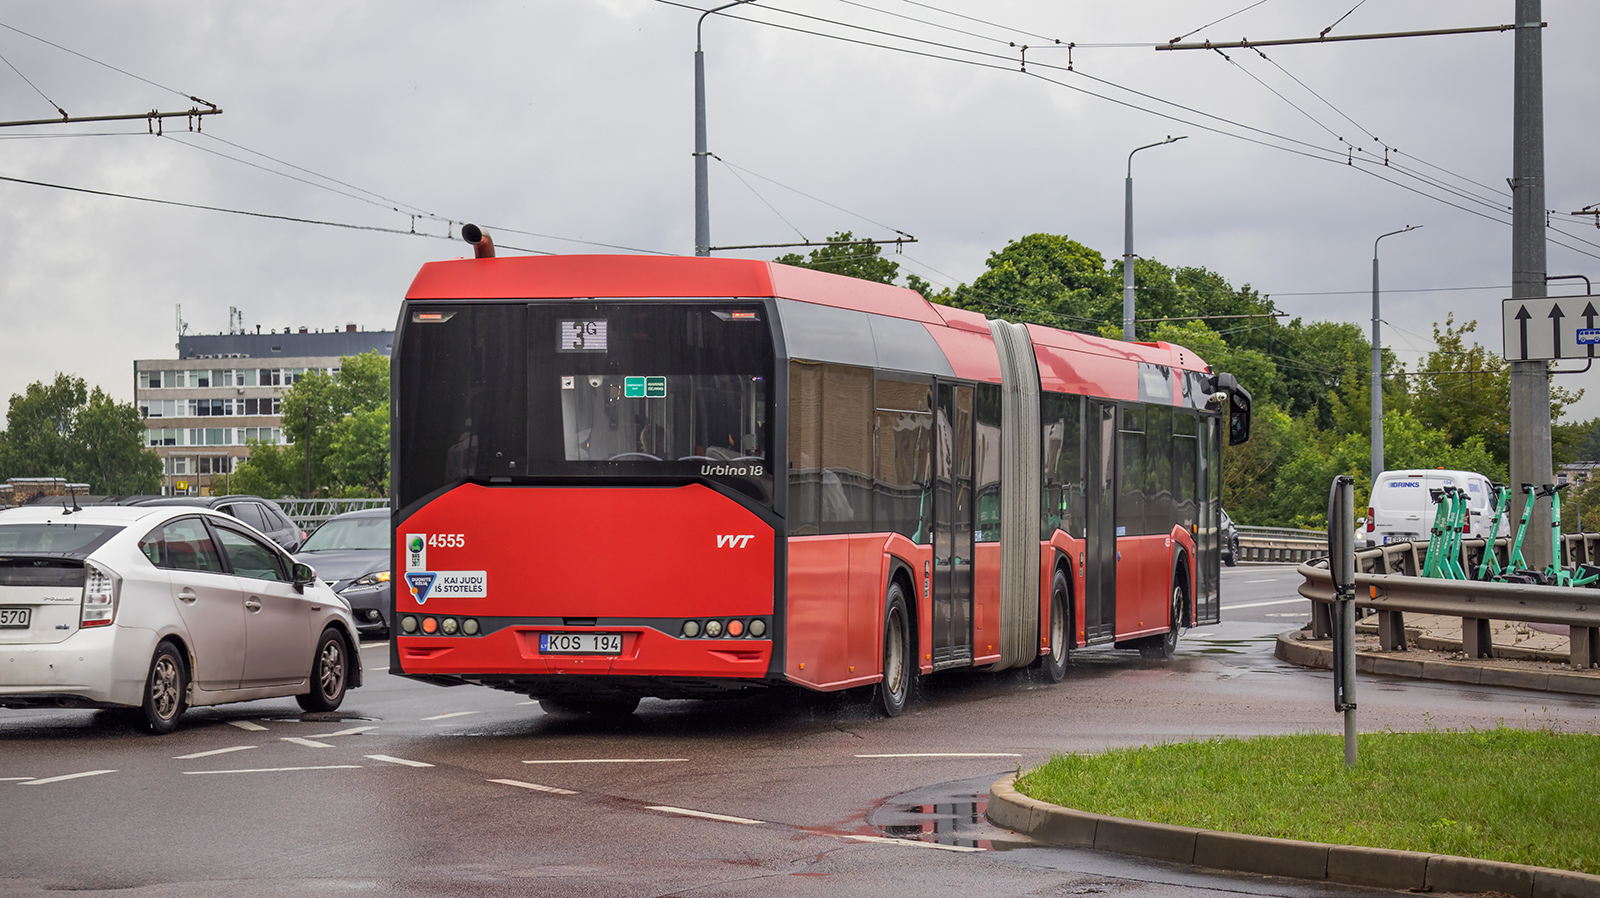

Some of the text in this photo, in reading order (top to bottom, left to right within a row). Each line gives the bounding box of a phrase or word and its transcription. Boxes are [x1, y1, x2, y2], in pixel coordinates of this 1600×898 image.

[701, 465, 764, 476] Urbino 18
[428, 533, 465, 548] 4555
[434, 584, 483, 592] IŠ STOTELĖS
[0, 610, 27, 624] 570
[549, 636, 581, 650] KOS
[593, 636, 618, 650] 194
